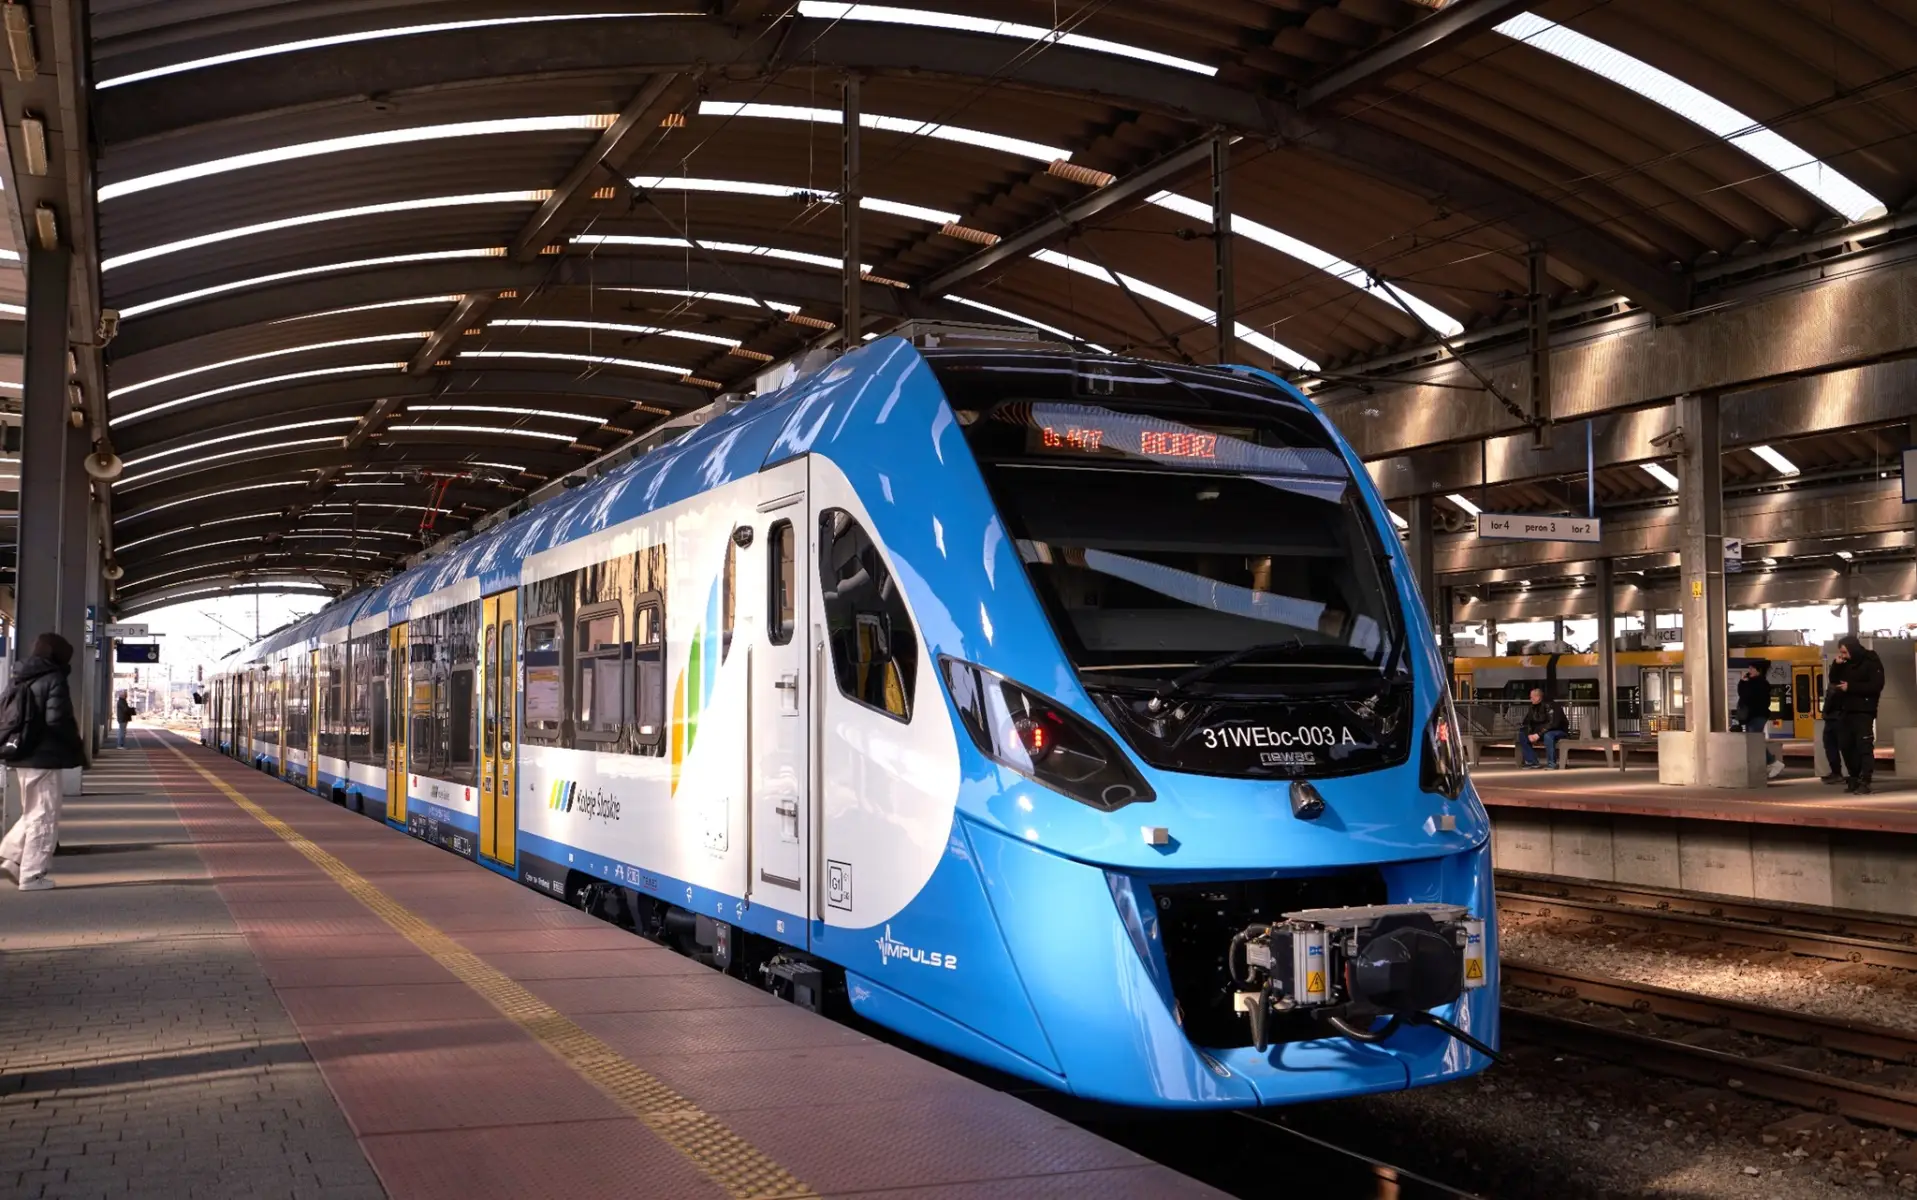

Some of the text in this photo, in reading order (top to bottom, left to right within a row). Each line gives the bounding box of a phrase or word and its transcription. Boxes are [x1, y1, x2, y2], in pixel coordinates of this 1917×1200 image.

[1490, 520, 1591, 534] tor 4 peron 3 tor 2
[1785, 684, 1792, 696] 2
[1202, 726, 1357, 748] 31WEbc-003 A
[944, 954, 957, 970] 2
